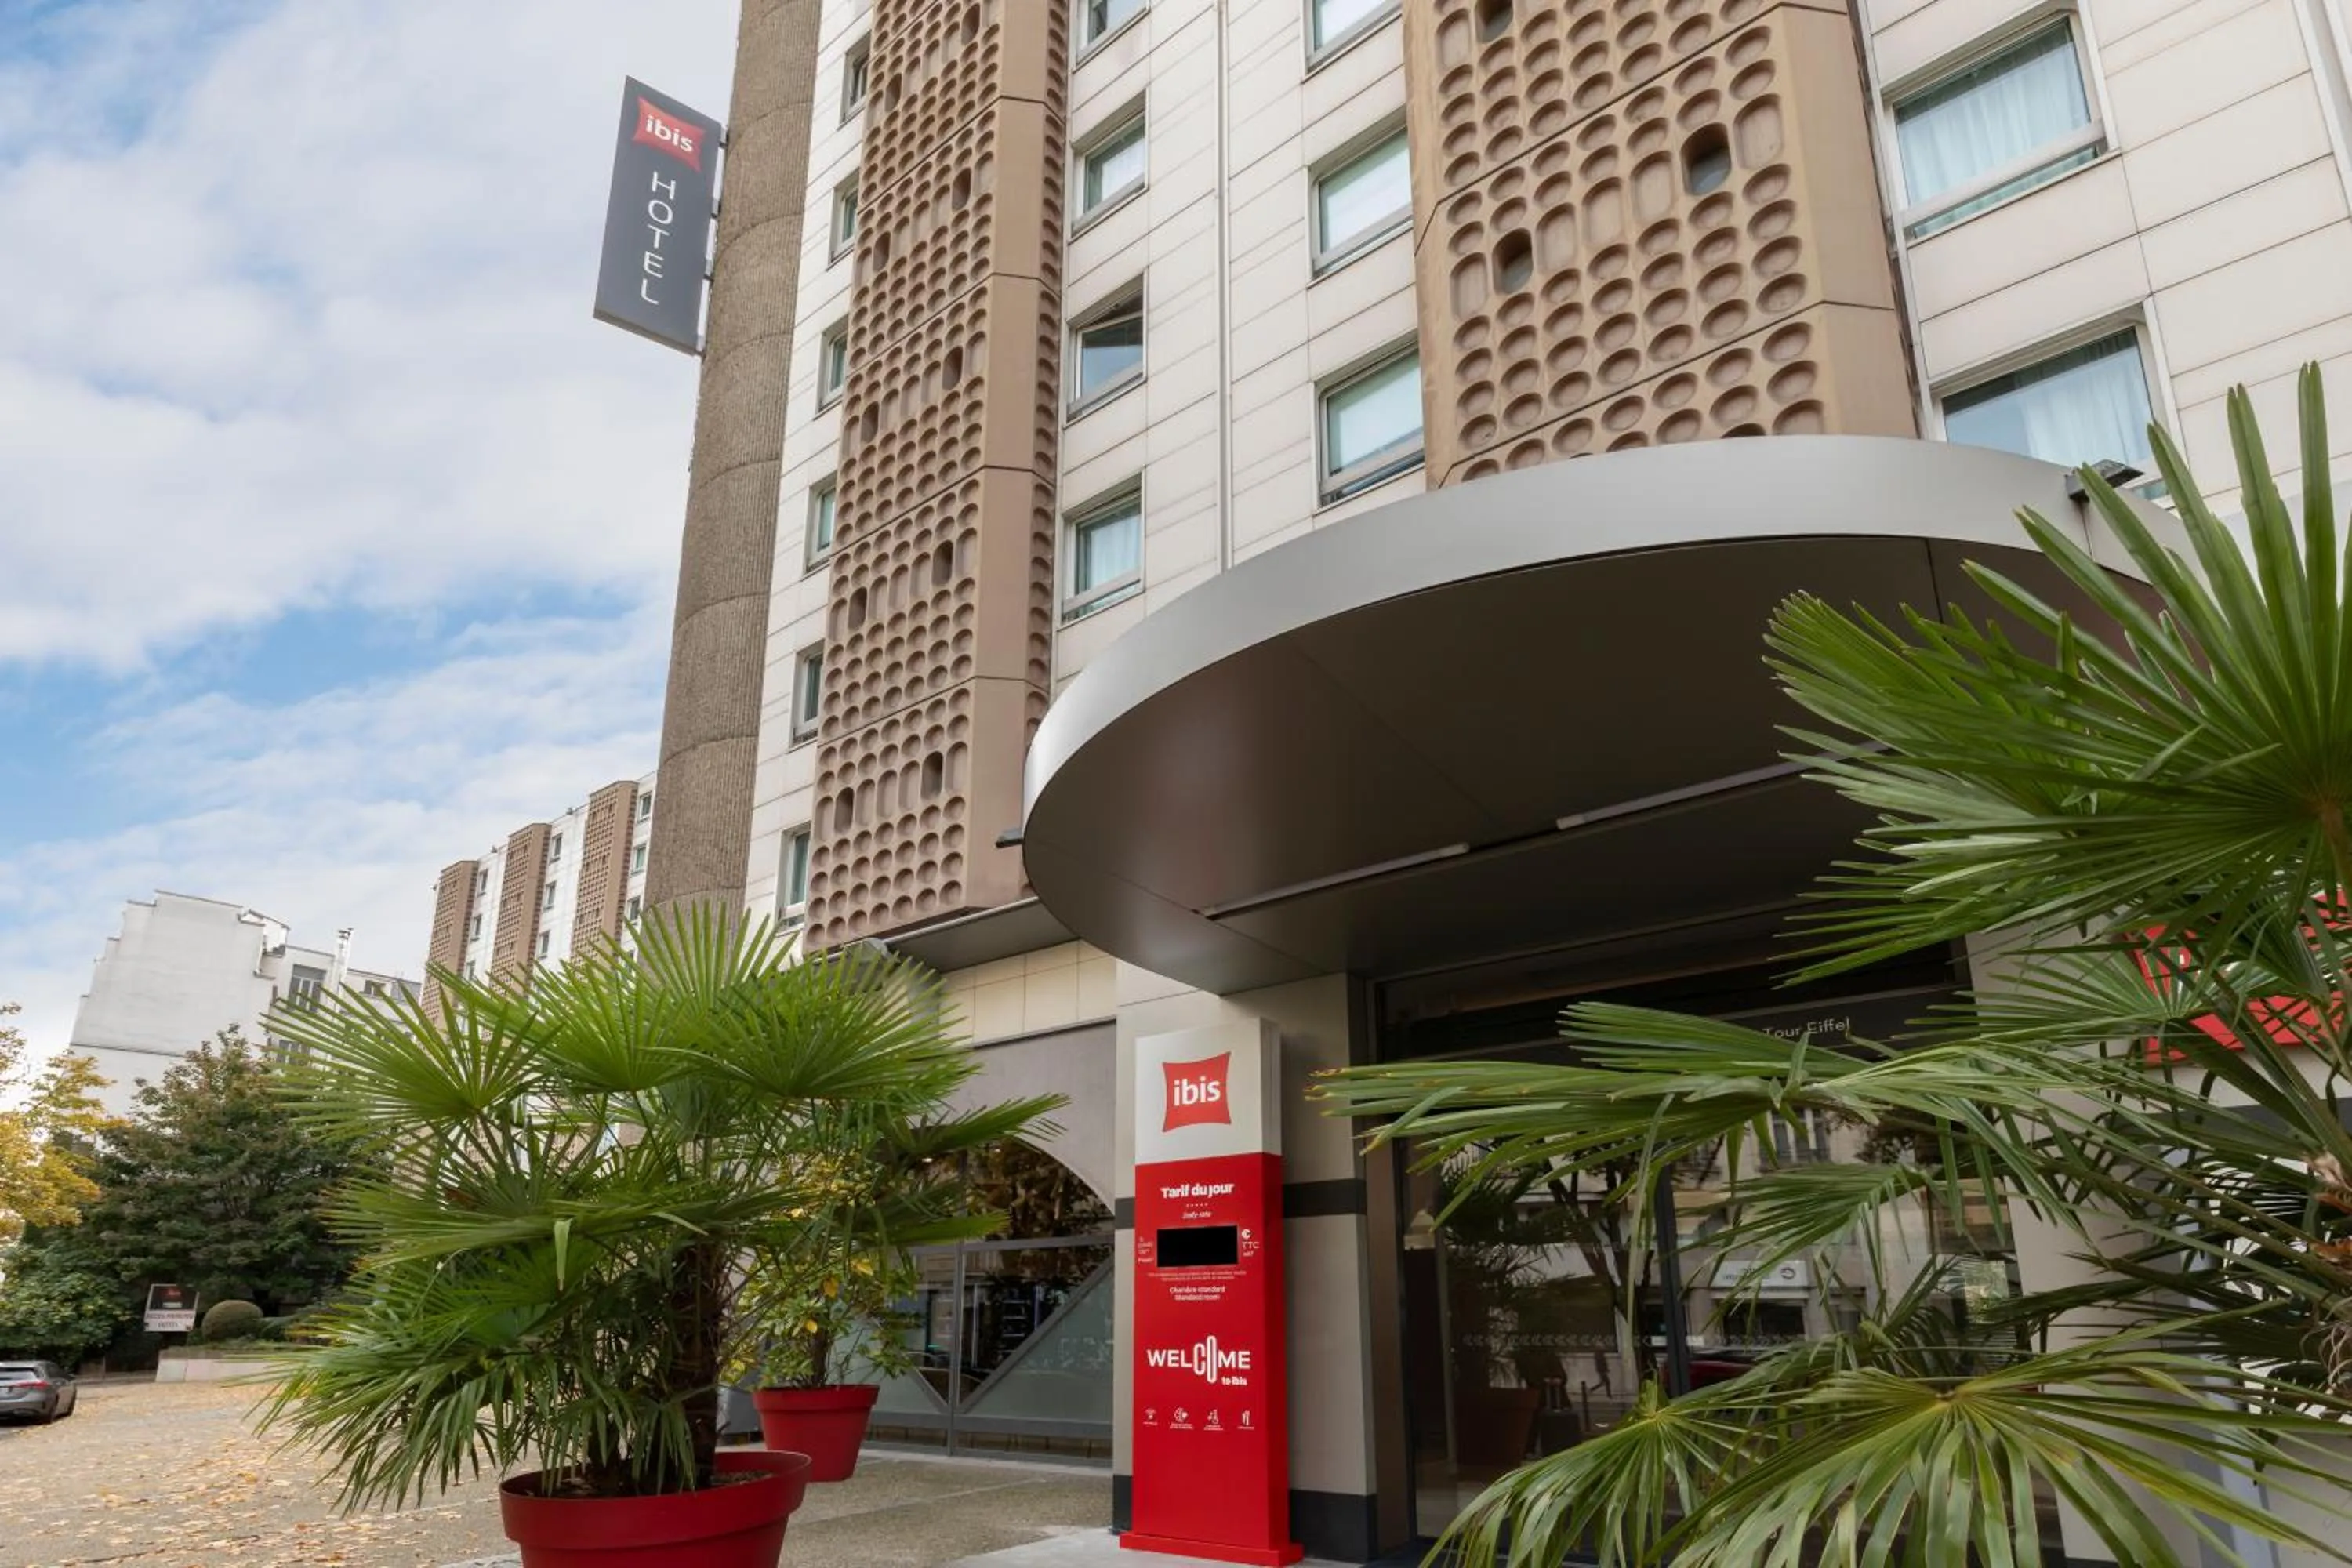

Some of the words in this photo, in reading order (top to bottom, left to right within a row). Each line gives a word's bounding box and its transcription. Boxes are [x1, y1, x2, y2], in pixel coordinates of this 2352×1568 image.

[645, 115, 694, 152] ibis
[641, 171, 676, 305] HOTEL
[1762, 1025, 1802, 1039] Tour
[1807, 1016, 1850, 1034] Eiffel
[1173, 1076, 1221, 1106] ibis
[1160, 1183, 1189, 1199] Tarif
[1191, 1183, 1207, 1196] du
[1208, 1183, 1235, 1198] jour
[1147, 1335, 1251, 1383] WELCOME
[1221, 1376, 1231, 1385] to
[1232, 1376, 1247, 1385] ibis
